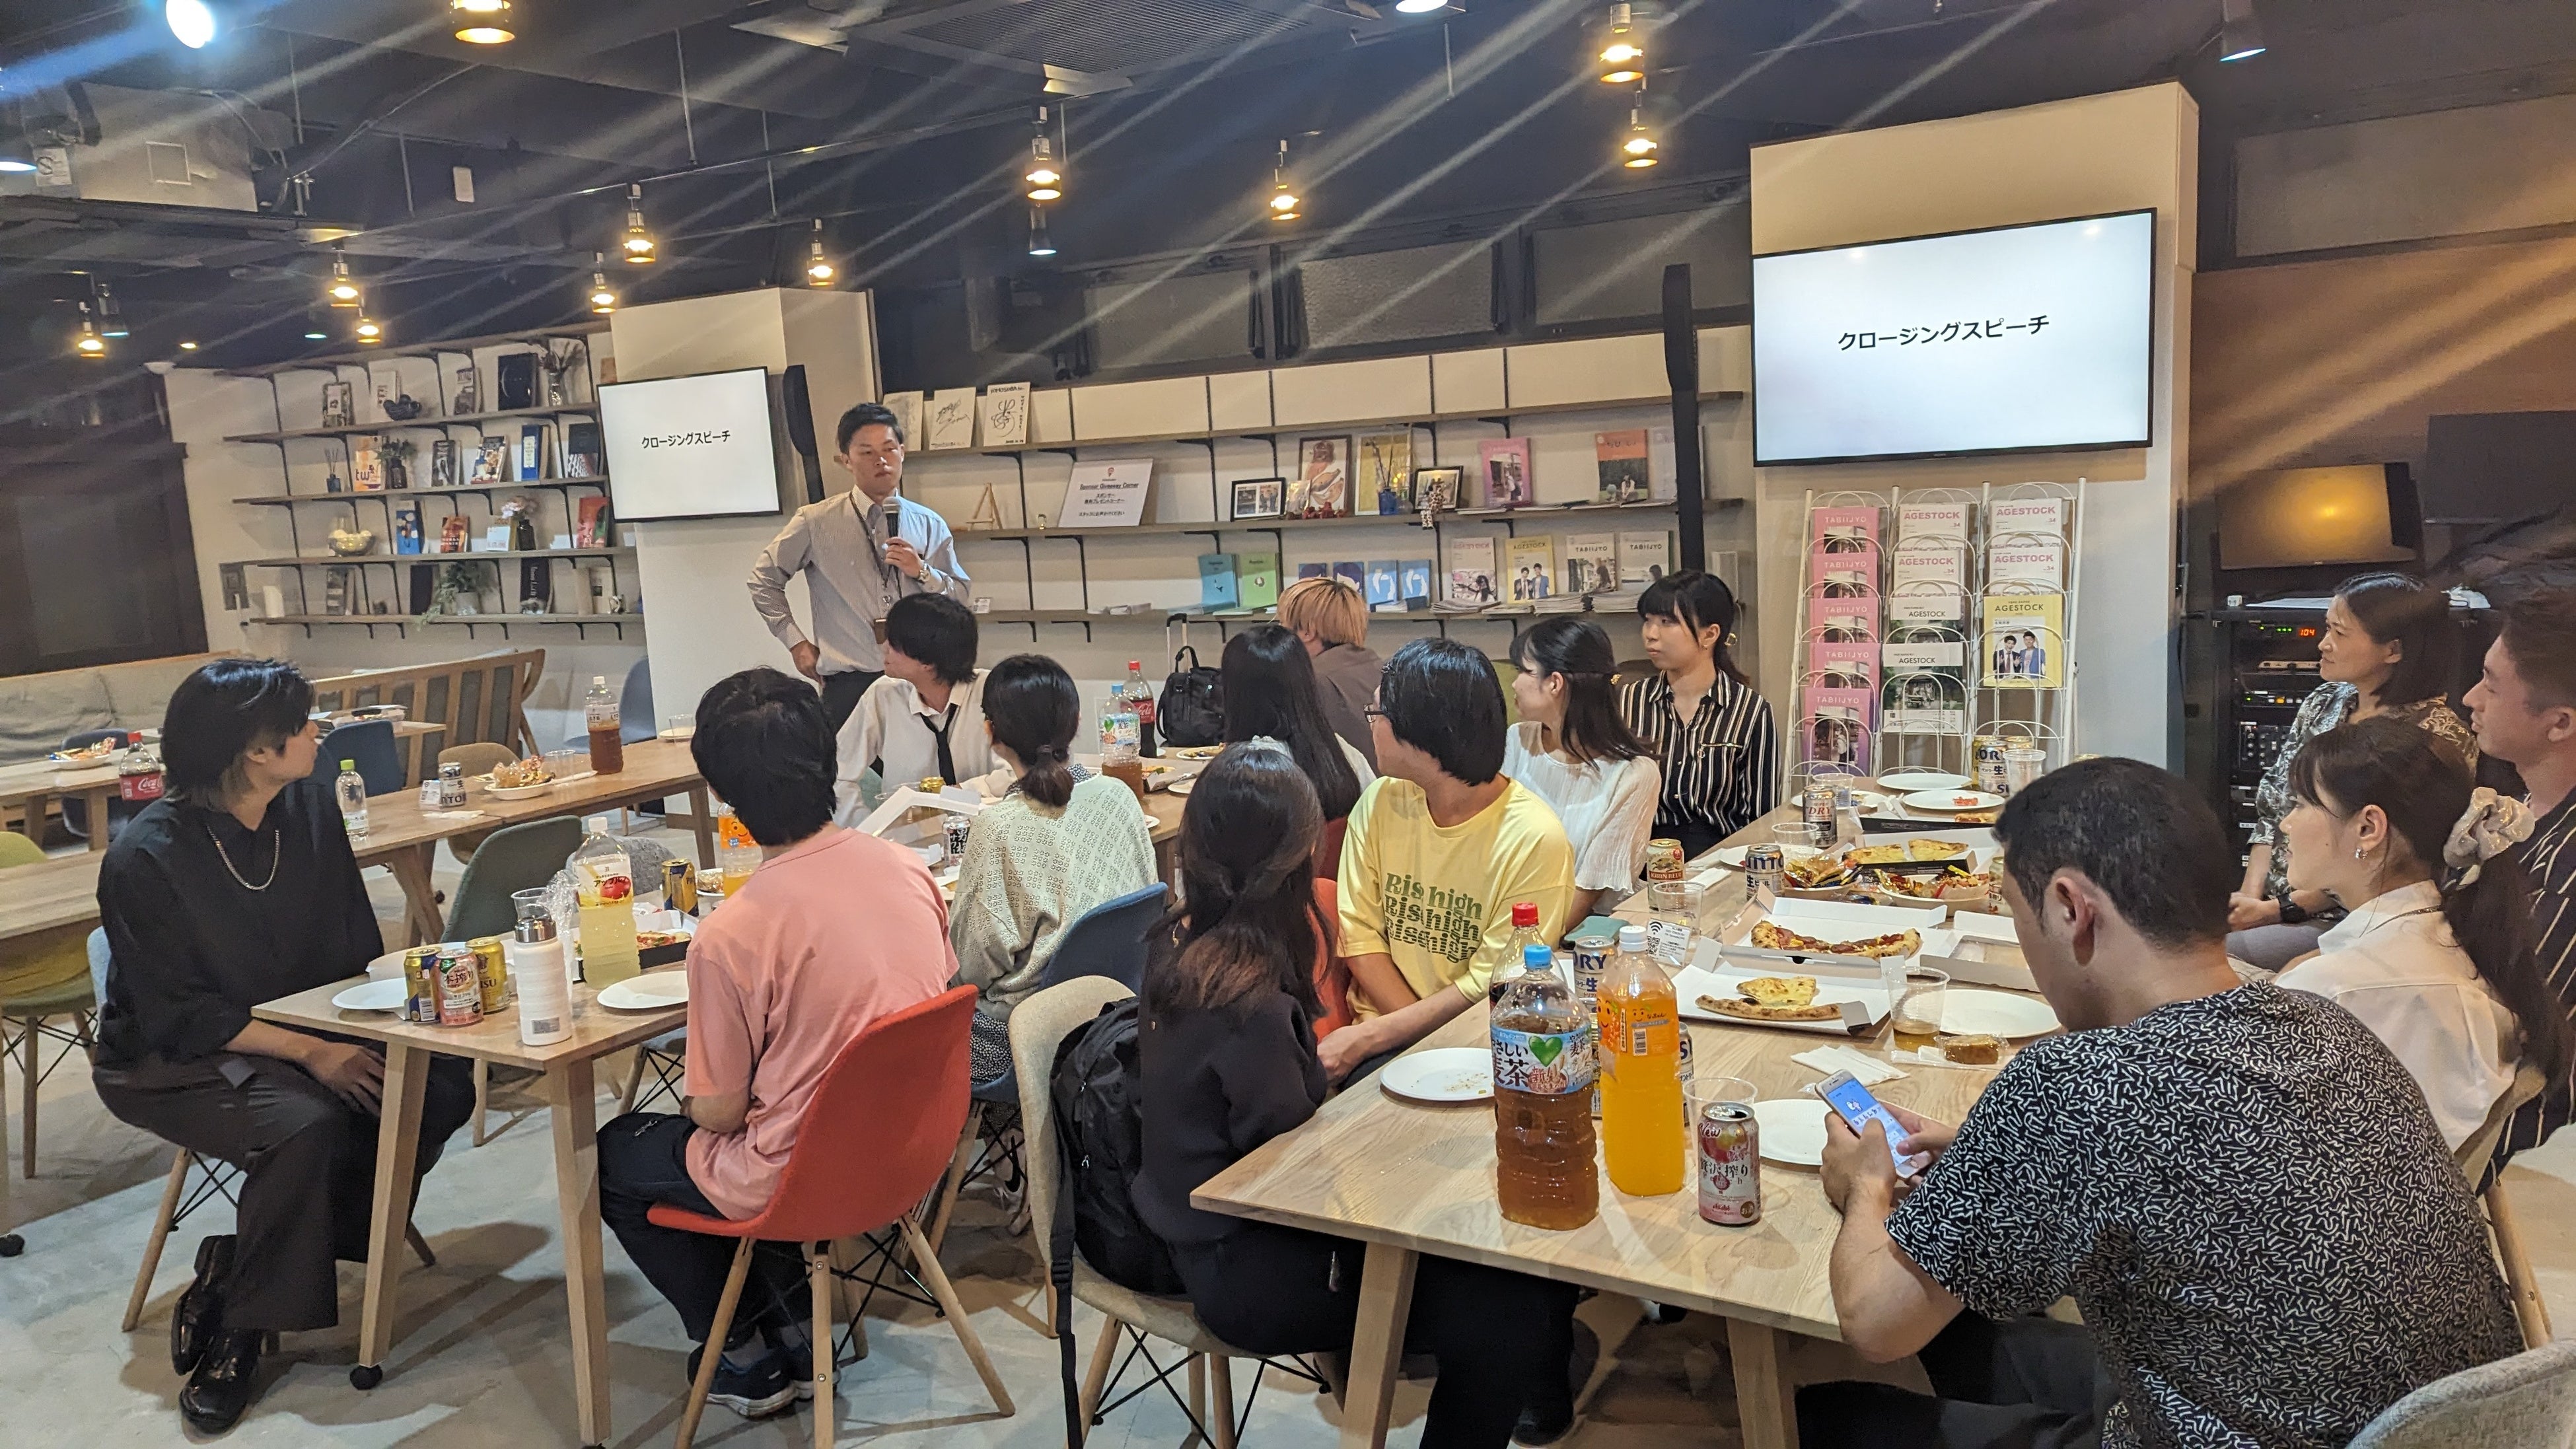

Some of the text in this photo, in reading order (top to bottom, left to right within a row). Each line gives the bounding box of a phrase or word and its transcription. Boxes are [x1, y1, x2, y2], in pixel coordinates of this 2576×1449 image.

[1838, 314, 2050, 351] クロージングスピーチ
[641, 430, 731, 448] クロージングスピーチ
[1997, 507, 2056, 515] AGESTOCK
[1995, 554, 2054, 563] AGESTOCK
[1427, 886, 1482, 920] high
[1493, 1053, 1530, 1087] 麦茶
[1698, 1123, 1721, 1137] New
